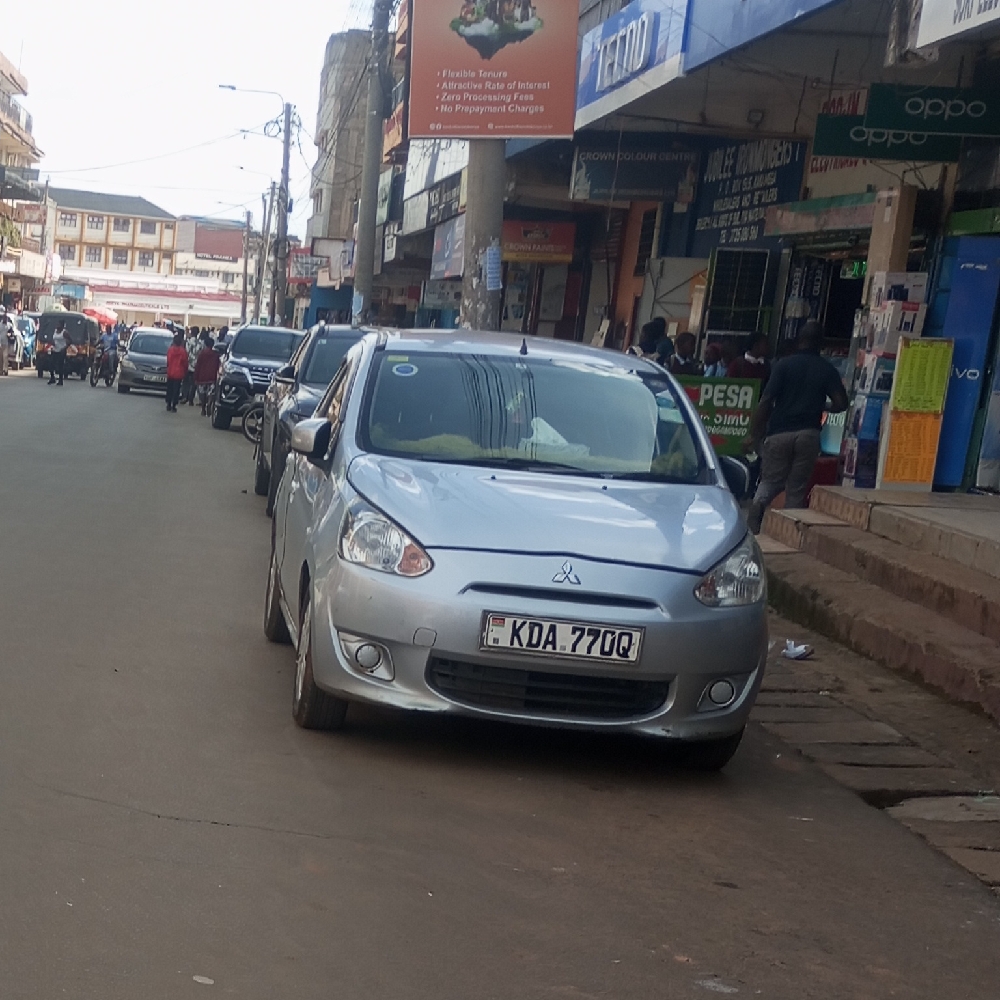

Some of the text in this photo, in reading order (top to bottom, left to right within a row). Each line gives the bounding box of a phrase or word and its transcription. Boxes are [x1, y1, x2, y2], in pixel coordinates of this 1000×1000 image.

[442, 69, 508, 78] Flexible Tenure
[441, 81, 550, 90] Attractive Rate of Interest
[441, 92, 534, 102] Zero Processing Fees
[440, 104, 544, 114] No Prepayment Charges
[905, 97, 987, 121] oppo
[579, 152, 697, 161] CROWN COLOUR CENTRE
[504, 242, 531, 251] CROWN
[950, 364, 980, 380] ivo
[699, 383, 753, 409] PESA
[509, 619, 633, 658] KDA 770Q
